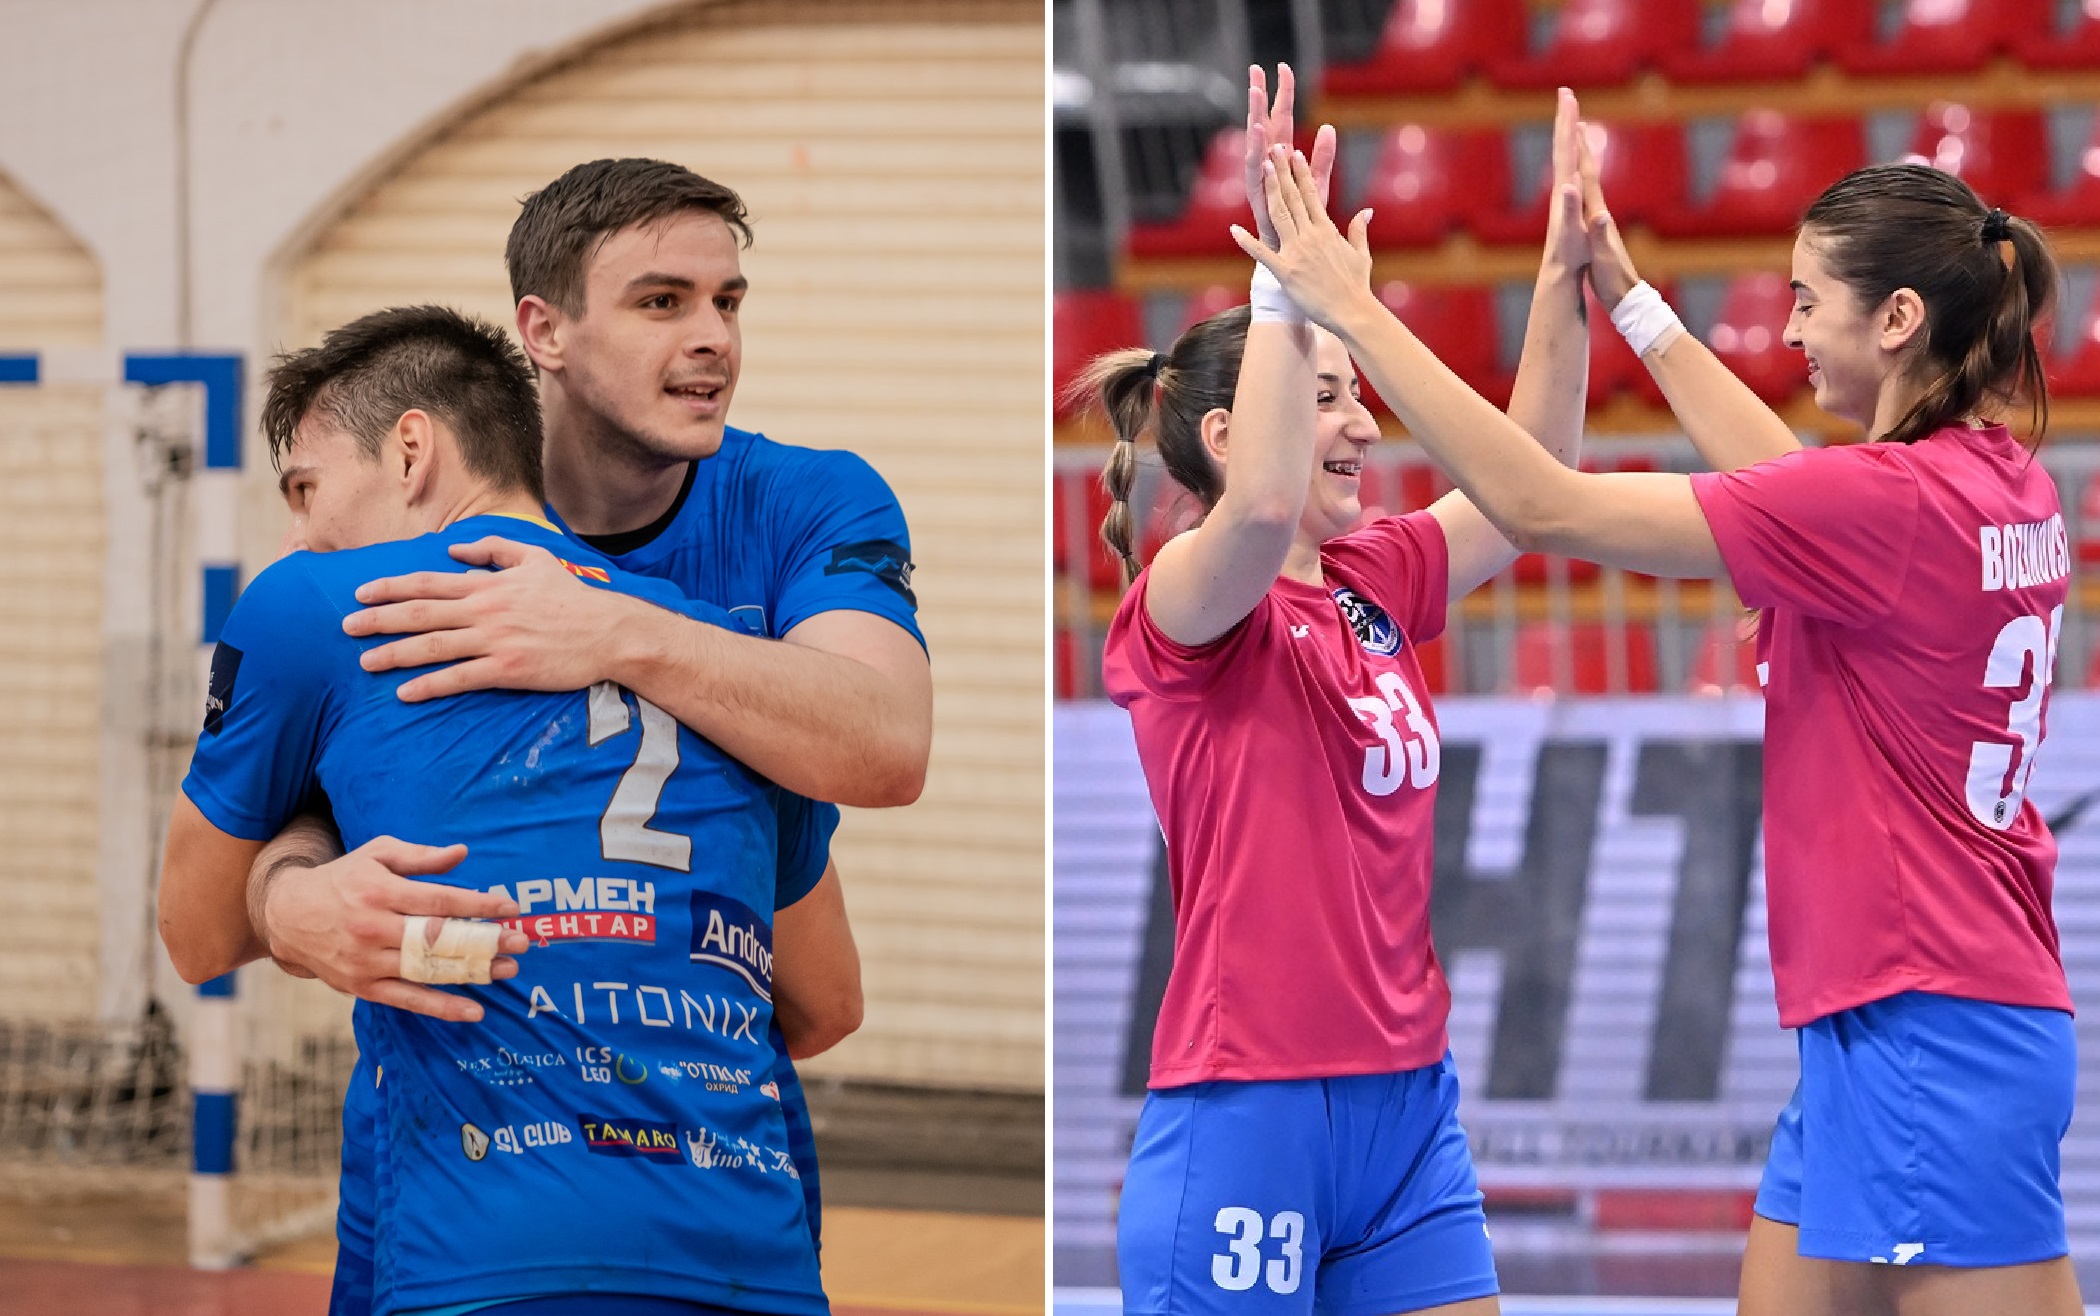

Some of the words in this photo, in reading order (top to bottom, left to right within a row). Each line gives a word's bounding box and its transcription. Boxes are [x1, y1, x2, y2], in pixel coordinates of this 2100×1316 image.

[1346, 672, 1440, 796] 33
[1966, 603, 2063, 830] 3
[588, 681, 691, 872] 2
[701, 909, 773, 982] Andros
[528, 982, 758, 1046] AITONIX
[576, 1047, 612, 1064] ICS
[581, 1065, 611, 1084] LEO
[706, 1082, 739, 1095] ОХРИД
[523, 1121, 573, 1147] CLUB
[1211, 1207, 1305, 1294] 33
